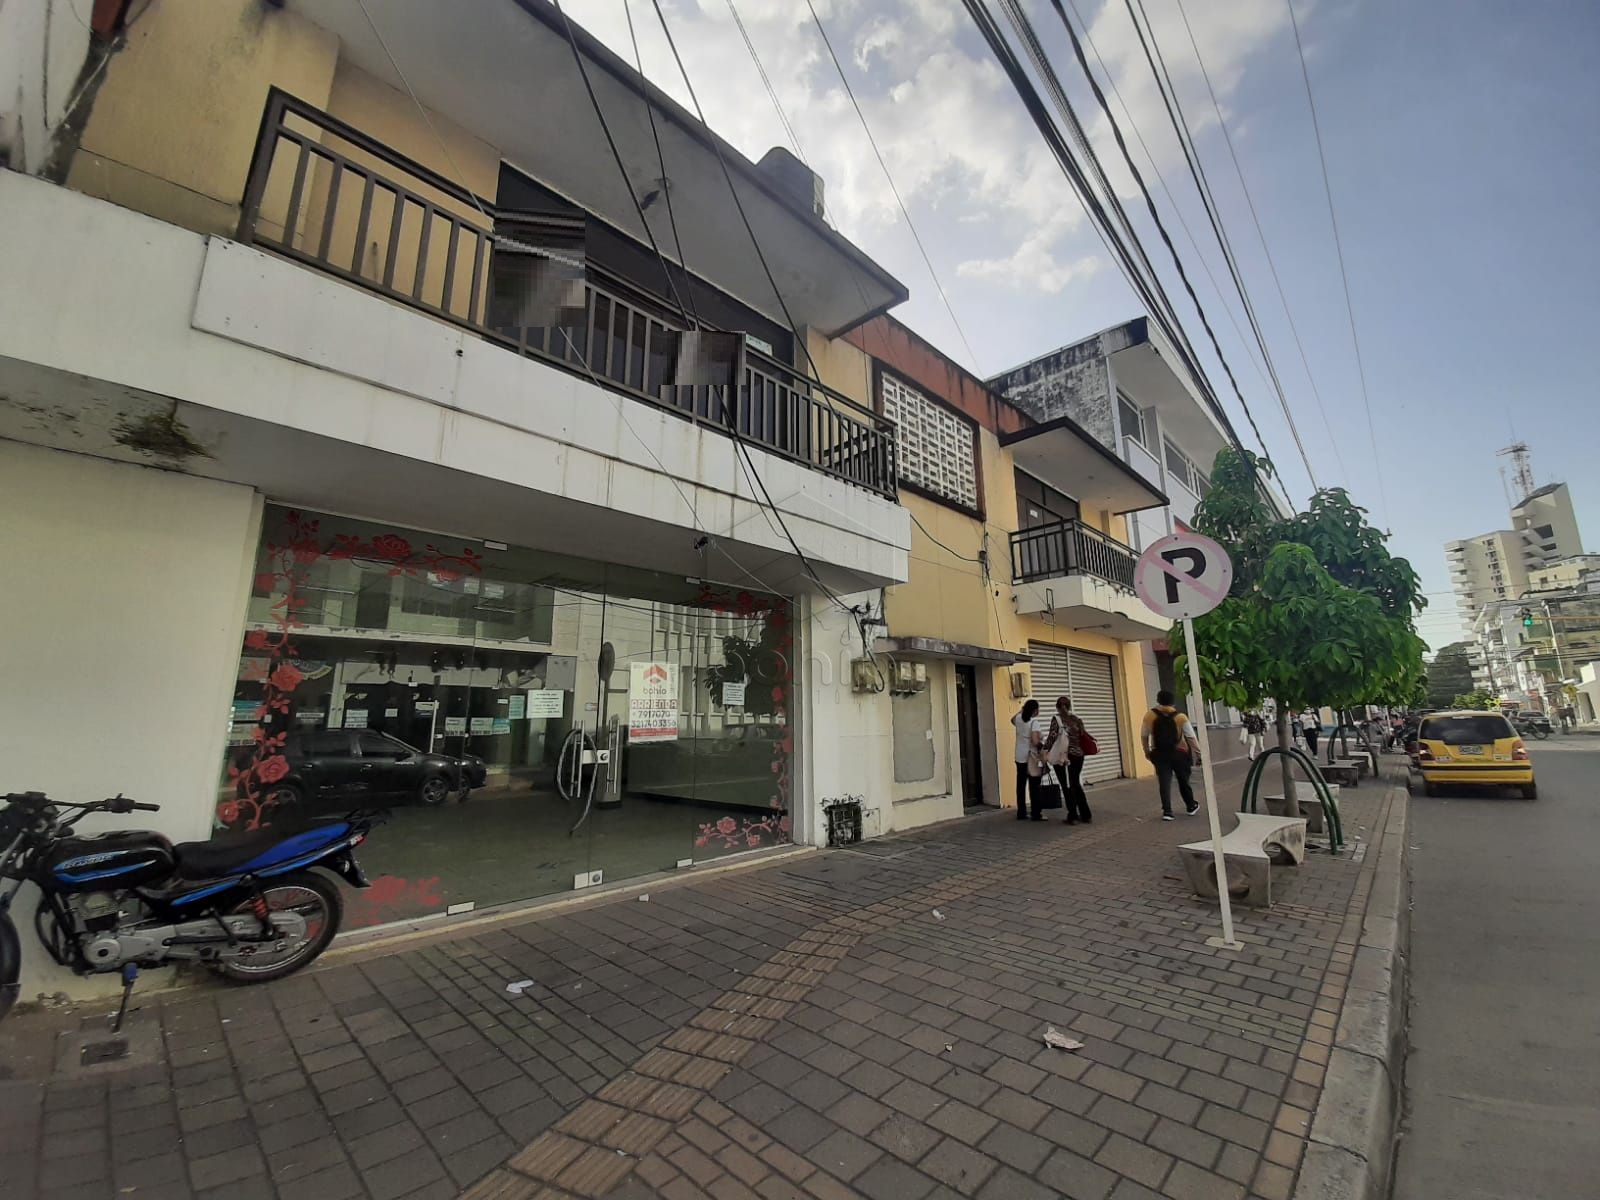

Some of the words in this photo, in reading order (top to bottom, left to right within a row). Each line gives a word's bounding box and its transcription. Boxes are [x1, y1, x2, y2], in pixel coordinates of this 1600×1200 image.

[1161, 547, 1207, 604] P
[631, 699, 678, 709] ARRIENDA
[638, 710, 671, 719] 7917070
